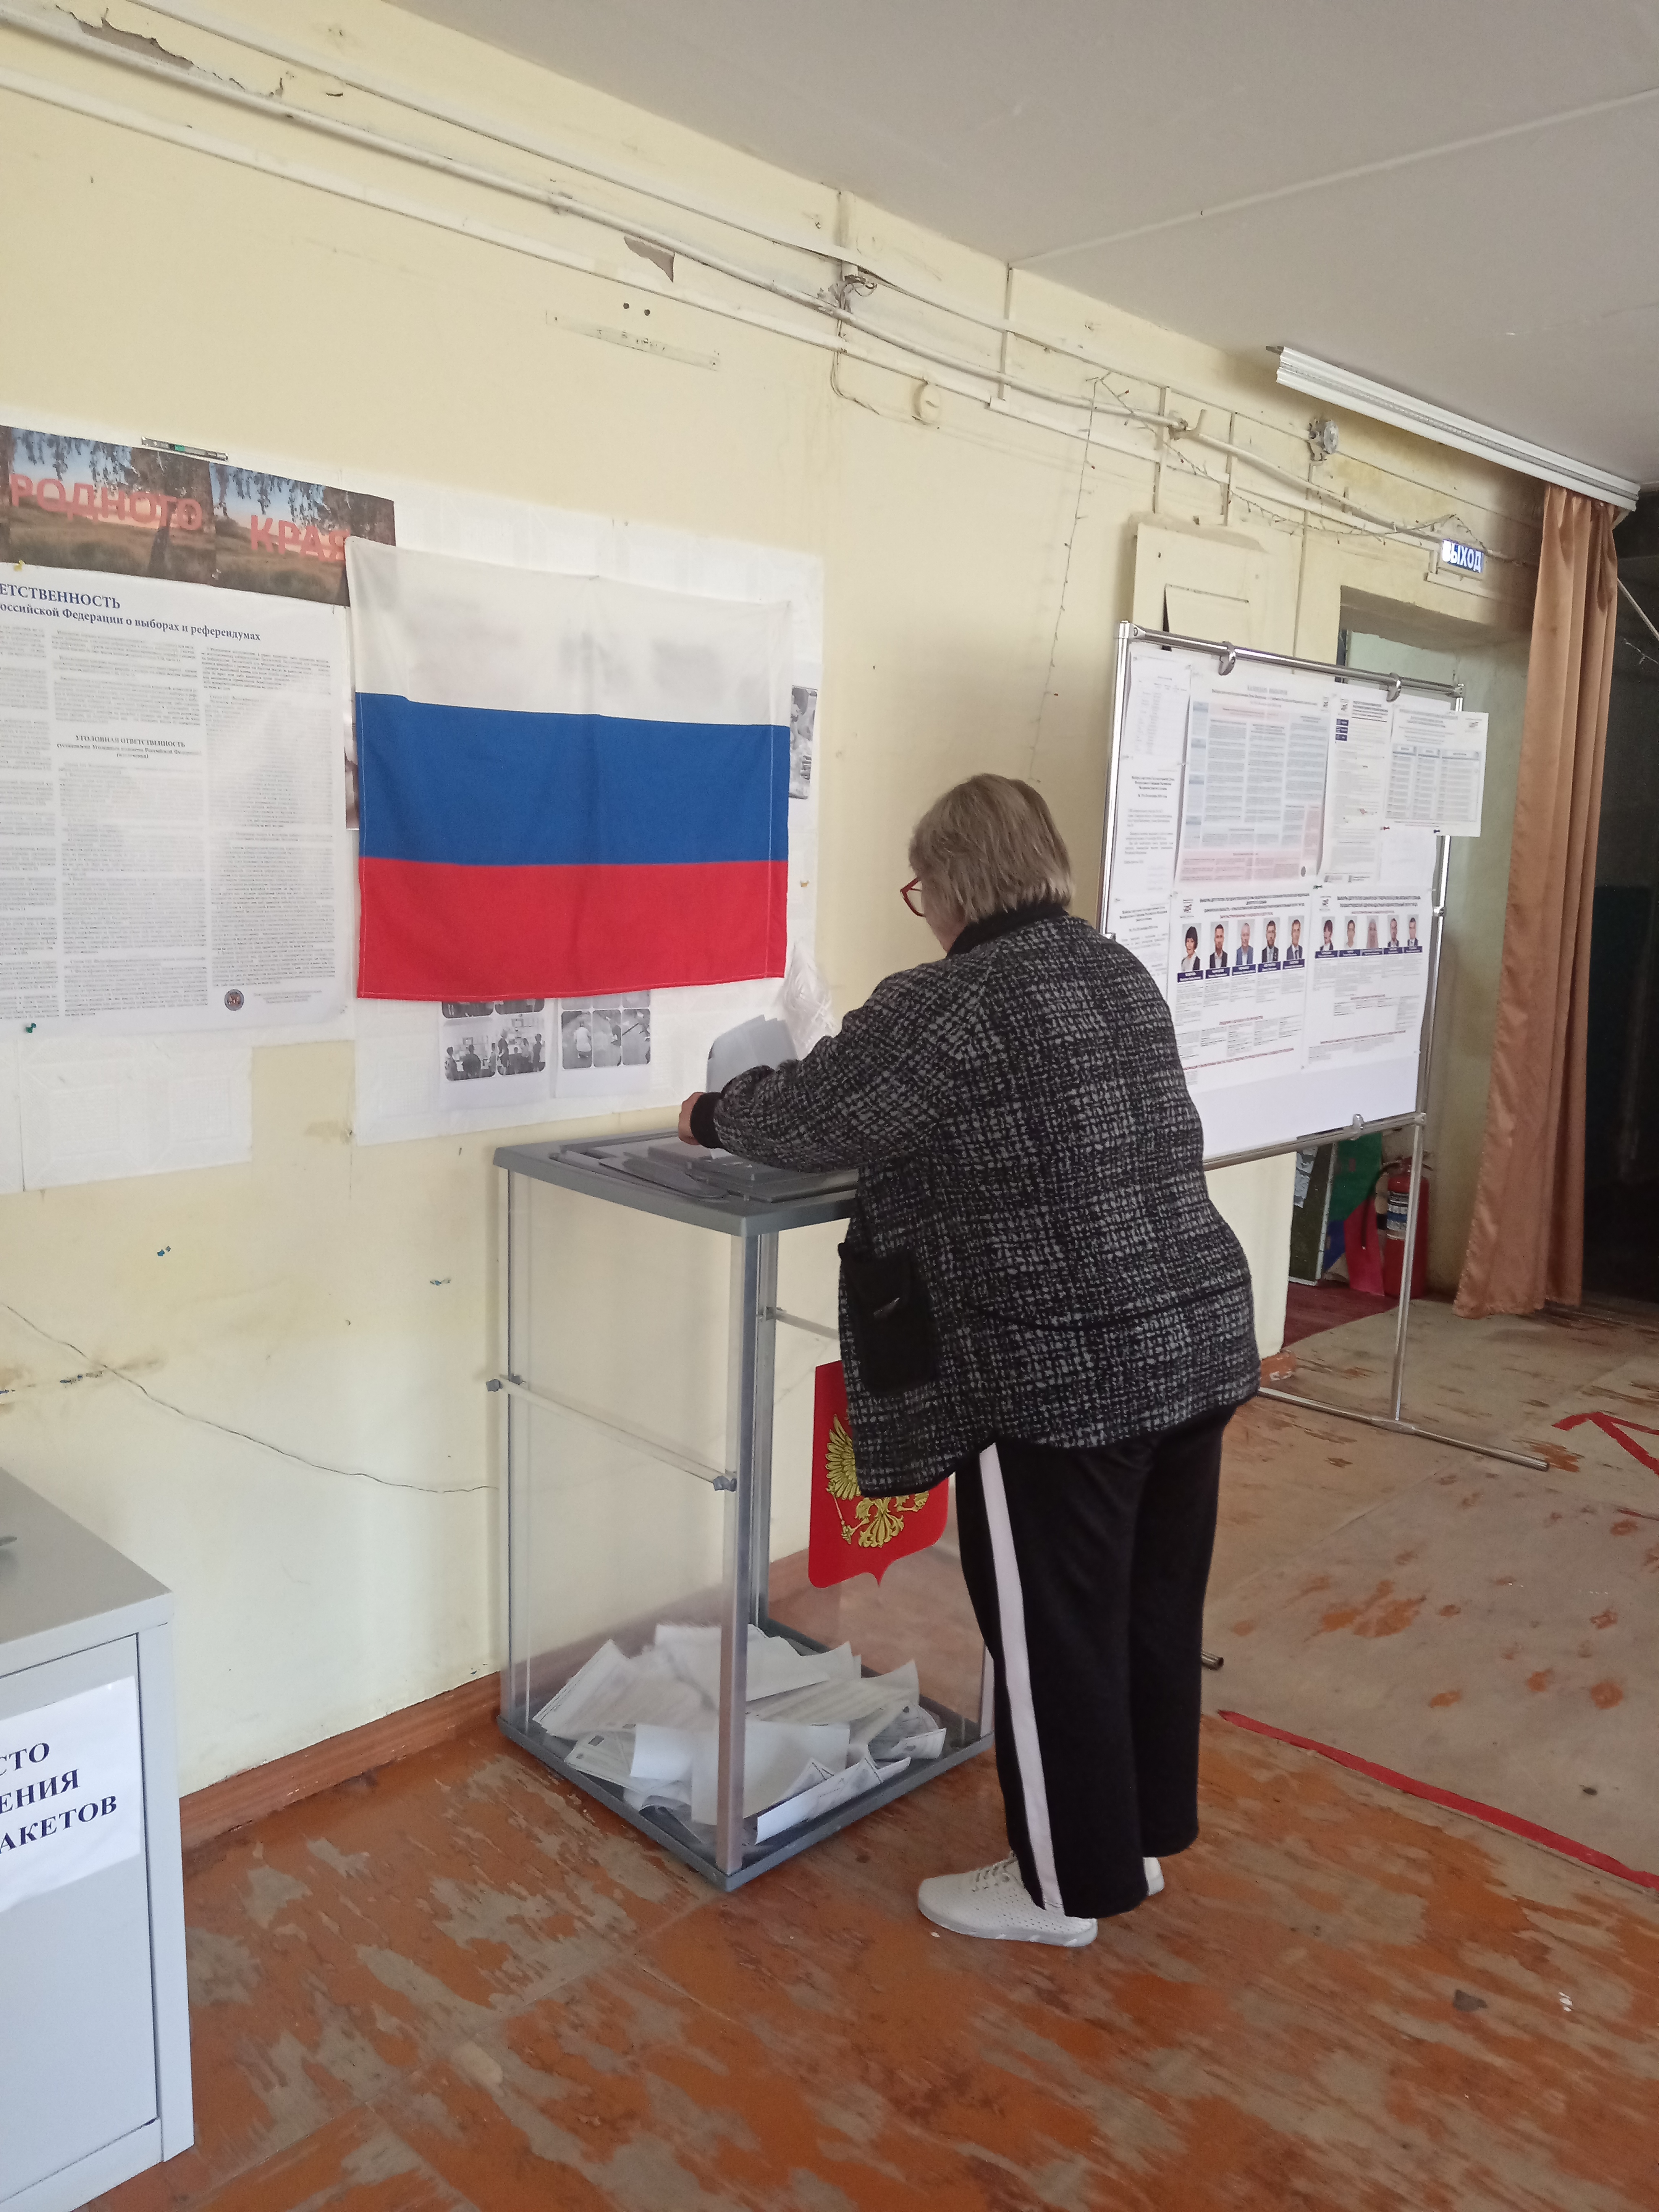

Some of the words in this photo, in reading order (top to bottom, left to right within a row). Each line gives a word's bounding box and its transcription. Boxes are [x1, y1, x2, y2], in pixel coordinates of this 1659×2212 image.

[10, 474, 203, 531] РОДНОГО
[251, 514, 350, 562] КРАЯ
[0, 583, 120, 609] ЕТСТВЕННОСТЬ
[0, 604, 60, 618] оссийской
[62, 608, 123, 624] Федерации
[135, 619, 179, 632] выборах
[182, 624, 189, 632] и
[190, 625, 261, 641] референдумах
[0, 1769, 80, 1814] ЕНИЯ
[0, 1796, 117, 1854] АКЕТОВ
